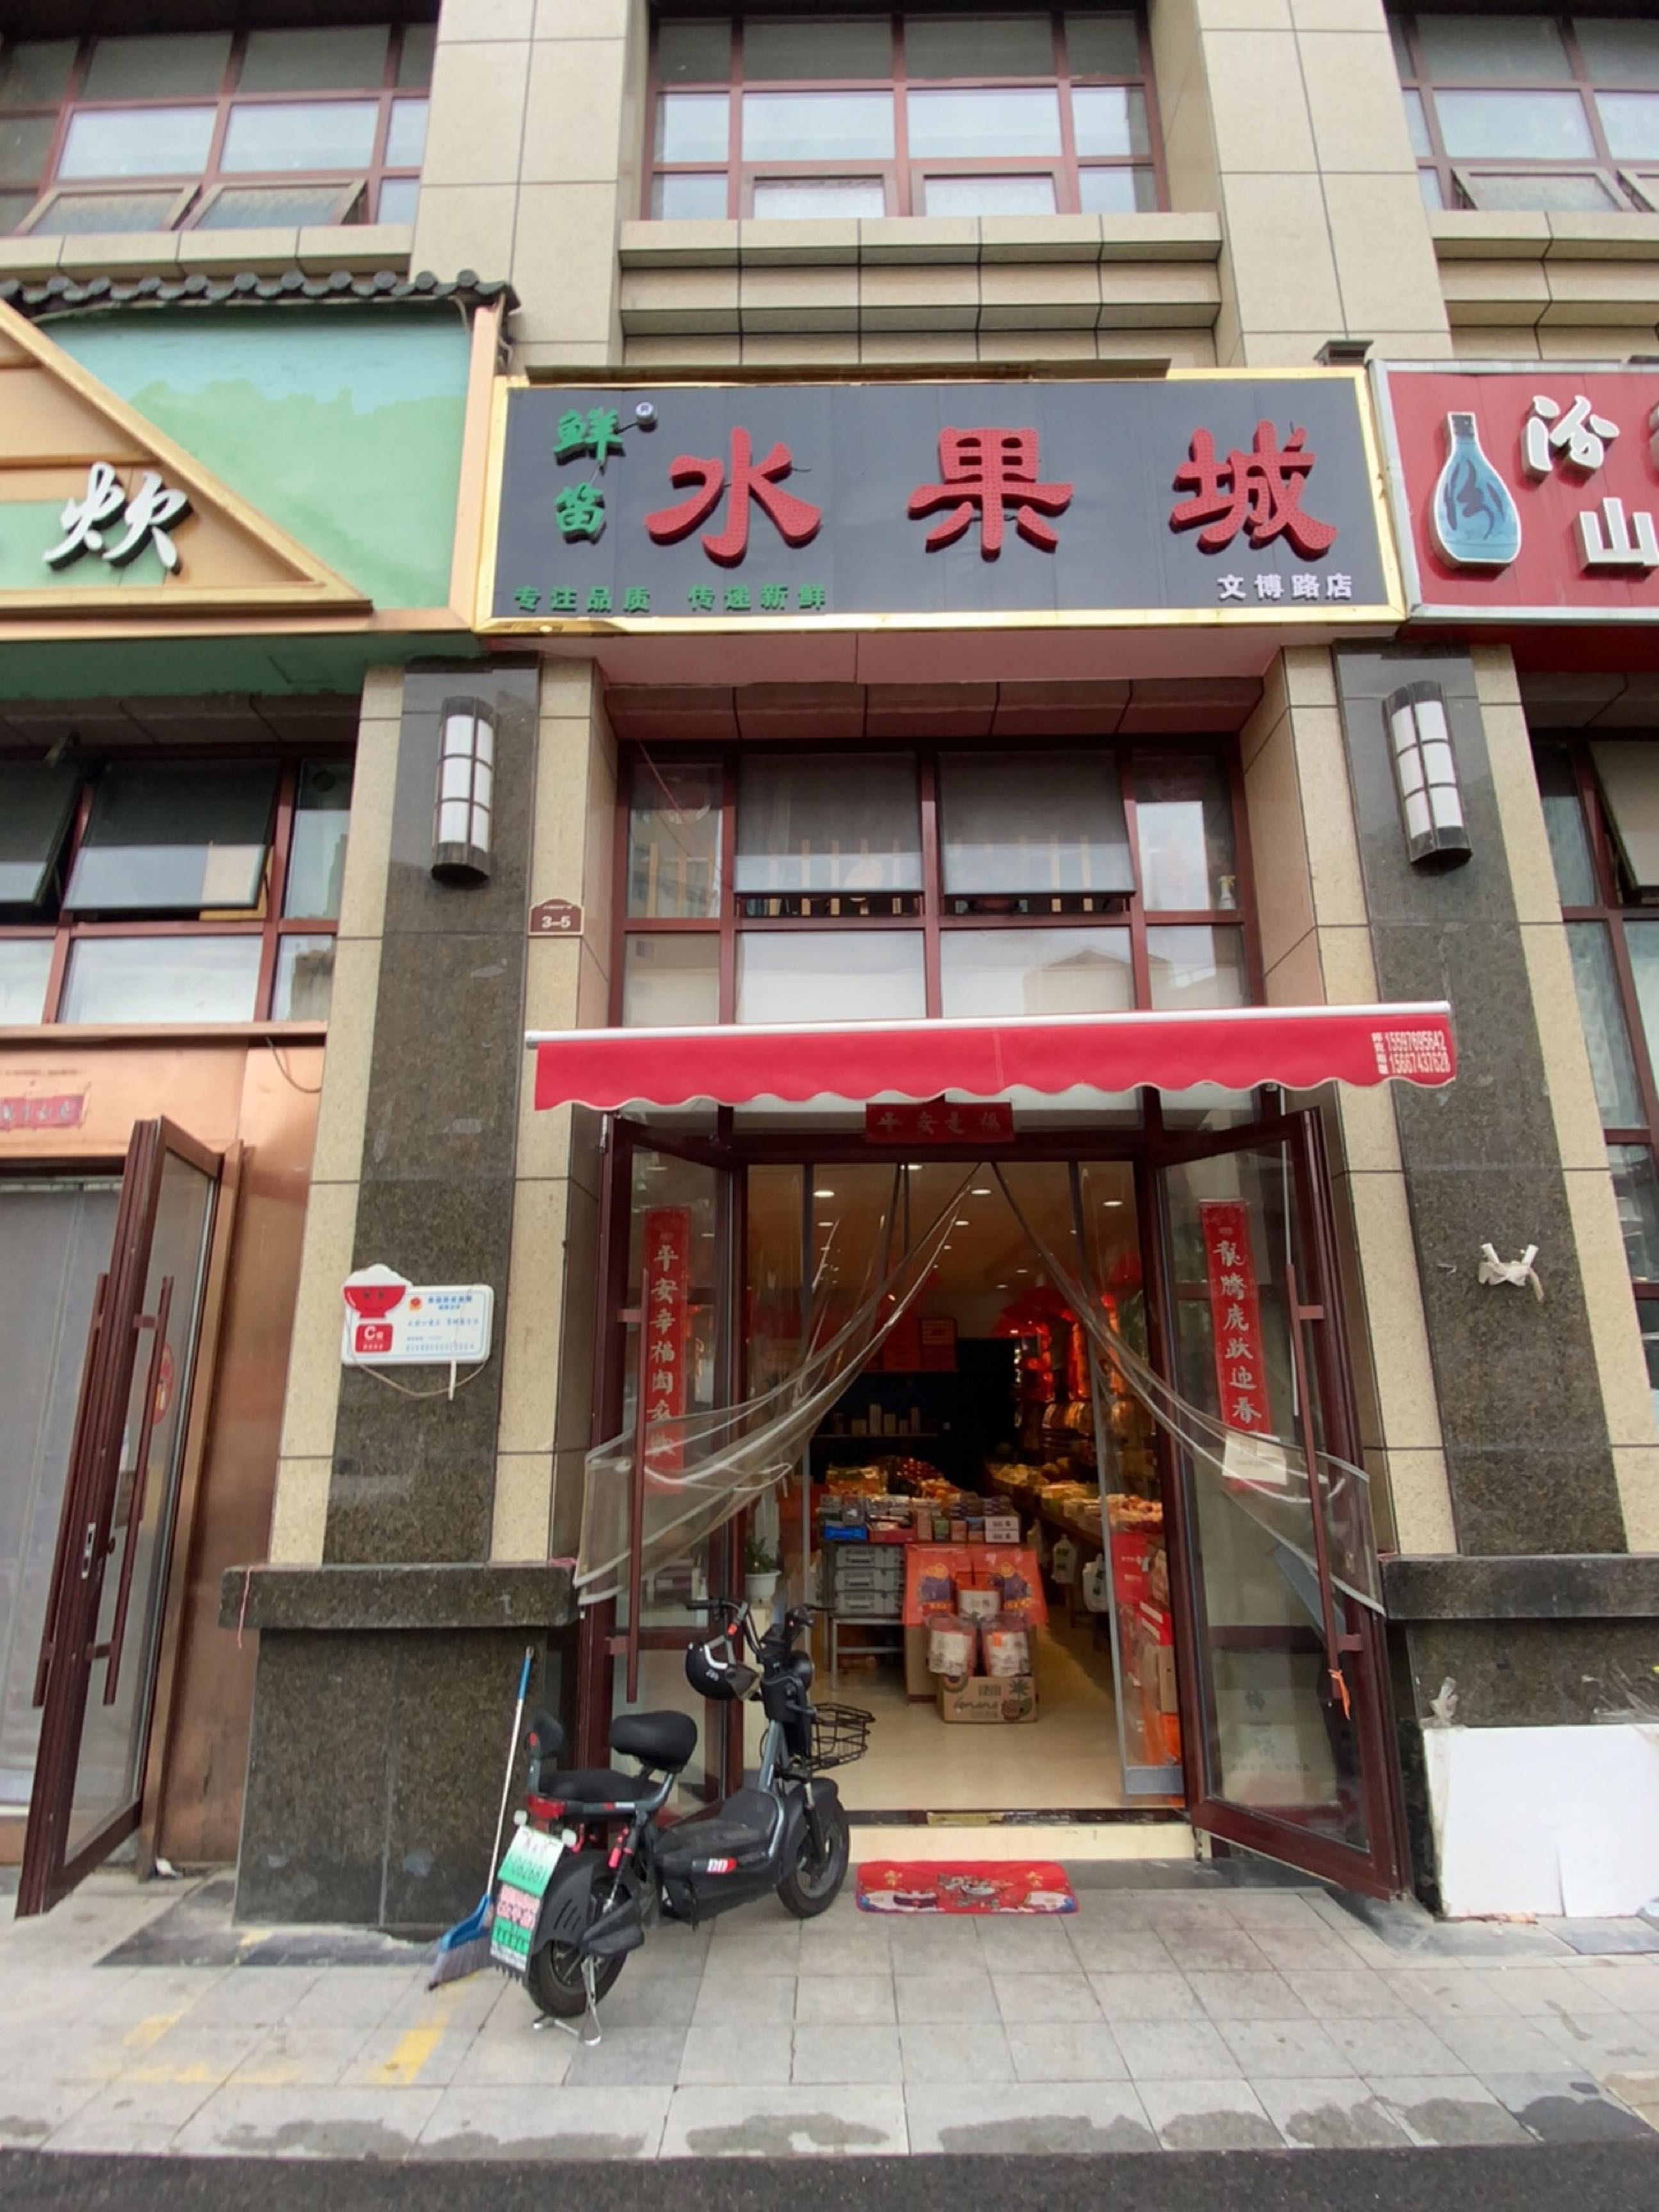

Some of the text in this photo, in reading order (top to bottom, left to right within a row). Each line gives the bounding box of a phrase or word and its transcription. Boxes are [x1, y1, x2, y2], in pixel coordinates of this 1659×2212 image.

[644, 419, 1340, 568] 水果城
[514, 584, 651, 613] 专注品质
[1217, 573, 1354, 600] 文博路店
